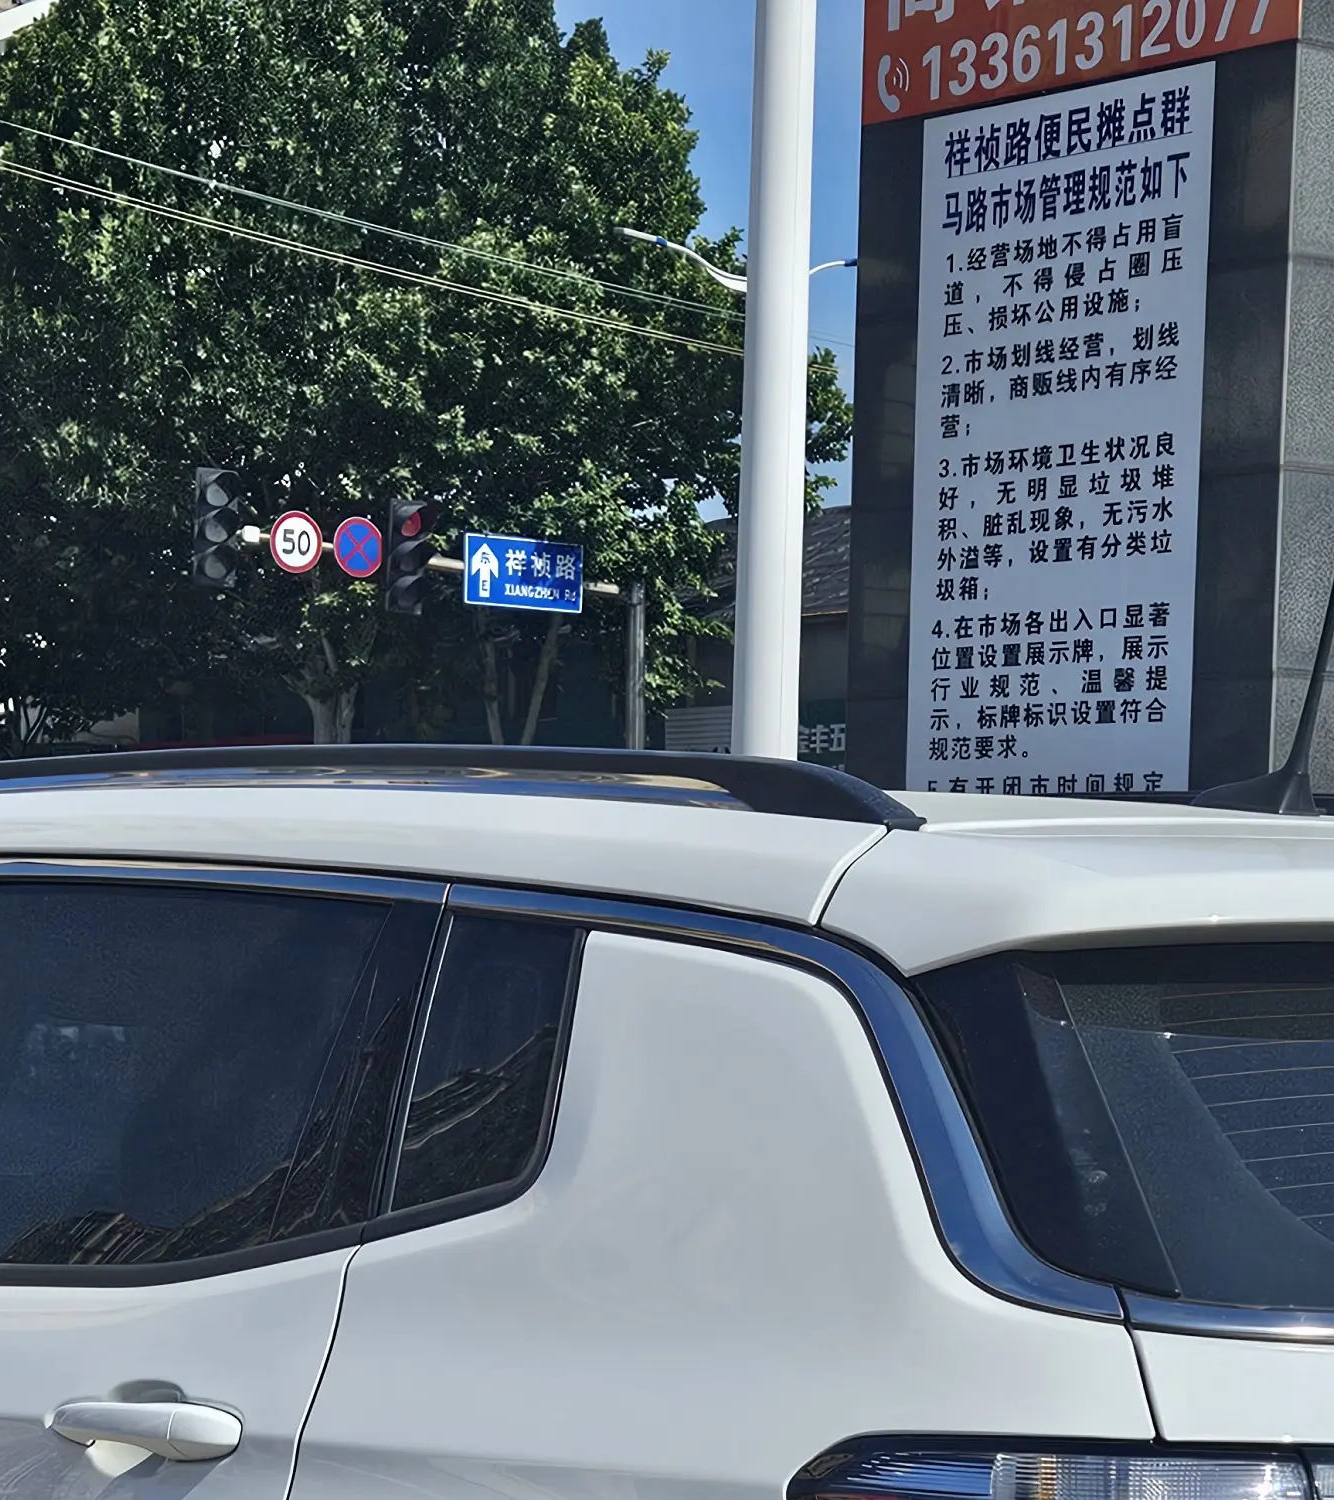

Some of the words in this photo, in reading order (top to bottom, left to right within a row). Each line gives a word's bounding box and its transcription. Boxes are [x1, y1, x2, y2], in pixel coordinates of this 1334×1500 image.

[922, 0, 1269, 101] 13361312077
[945, 86, 1190, 177] 祥祯路便民摊点群
[942, 152, 1190, 236] 马路市场管理规范如下
[946, 213, 1184, 273] 1.经营场地不得占用盲
[940, 414, 971, 439] 营；
[938, 432, 1175, 478] 3.市场环境卫生状况良
[282, 528, 310, 556] 50
[936, 576, 989, 601] 圾箱；
[931, 601, 1170, 639] 4.在市场各出入口显著
[929, 734, 1029, 761] 规范要求。
